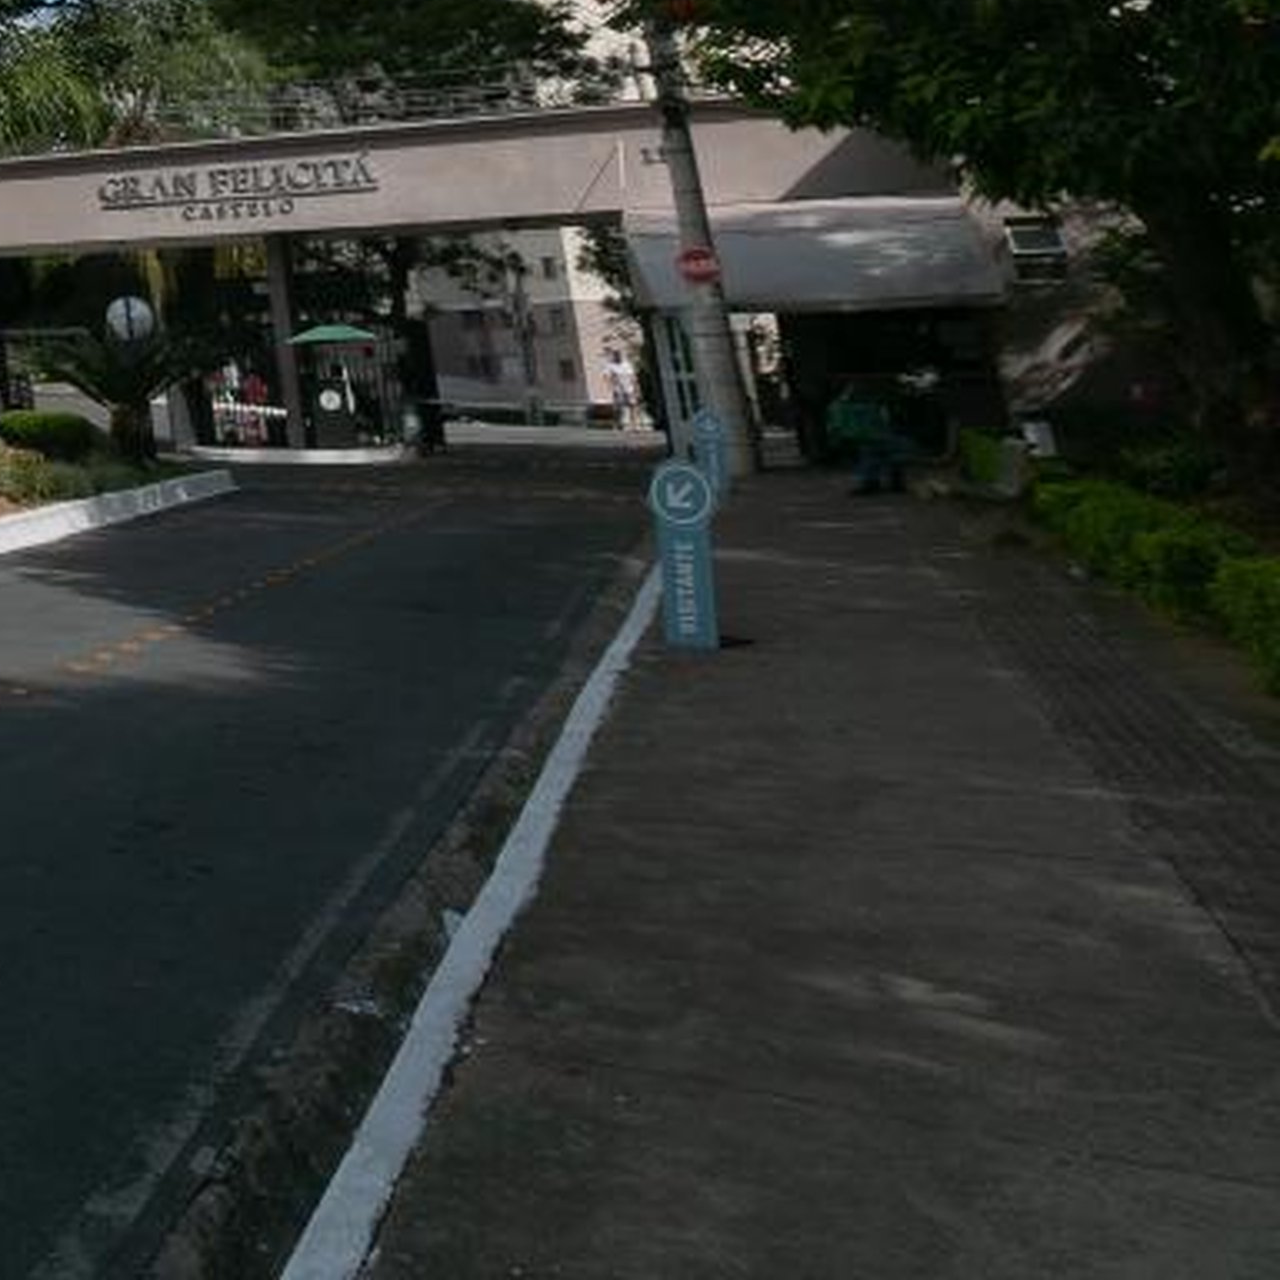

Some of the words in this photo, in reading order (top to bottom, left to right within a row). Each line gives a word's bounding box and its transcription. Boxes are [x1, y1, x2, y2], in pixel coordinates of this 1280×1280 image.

[98, 173, 196, 204] GRAN
[183, 200, 294, 221] CASTELO
[674, 541, 695, 635] VISITANTE
